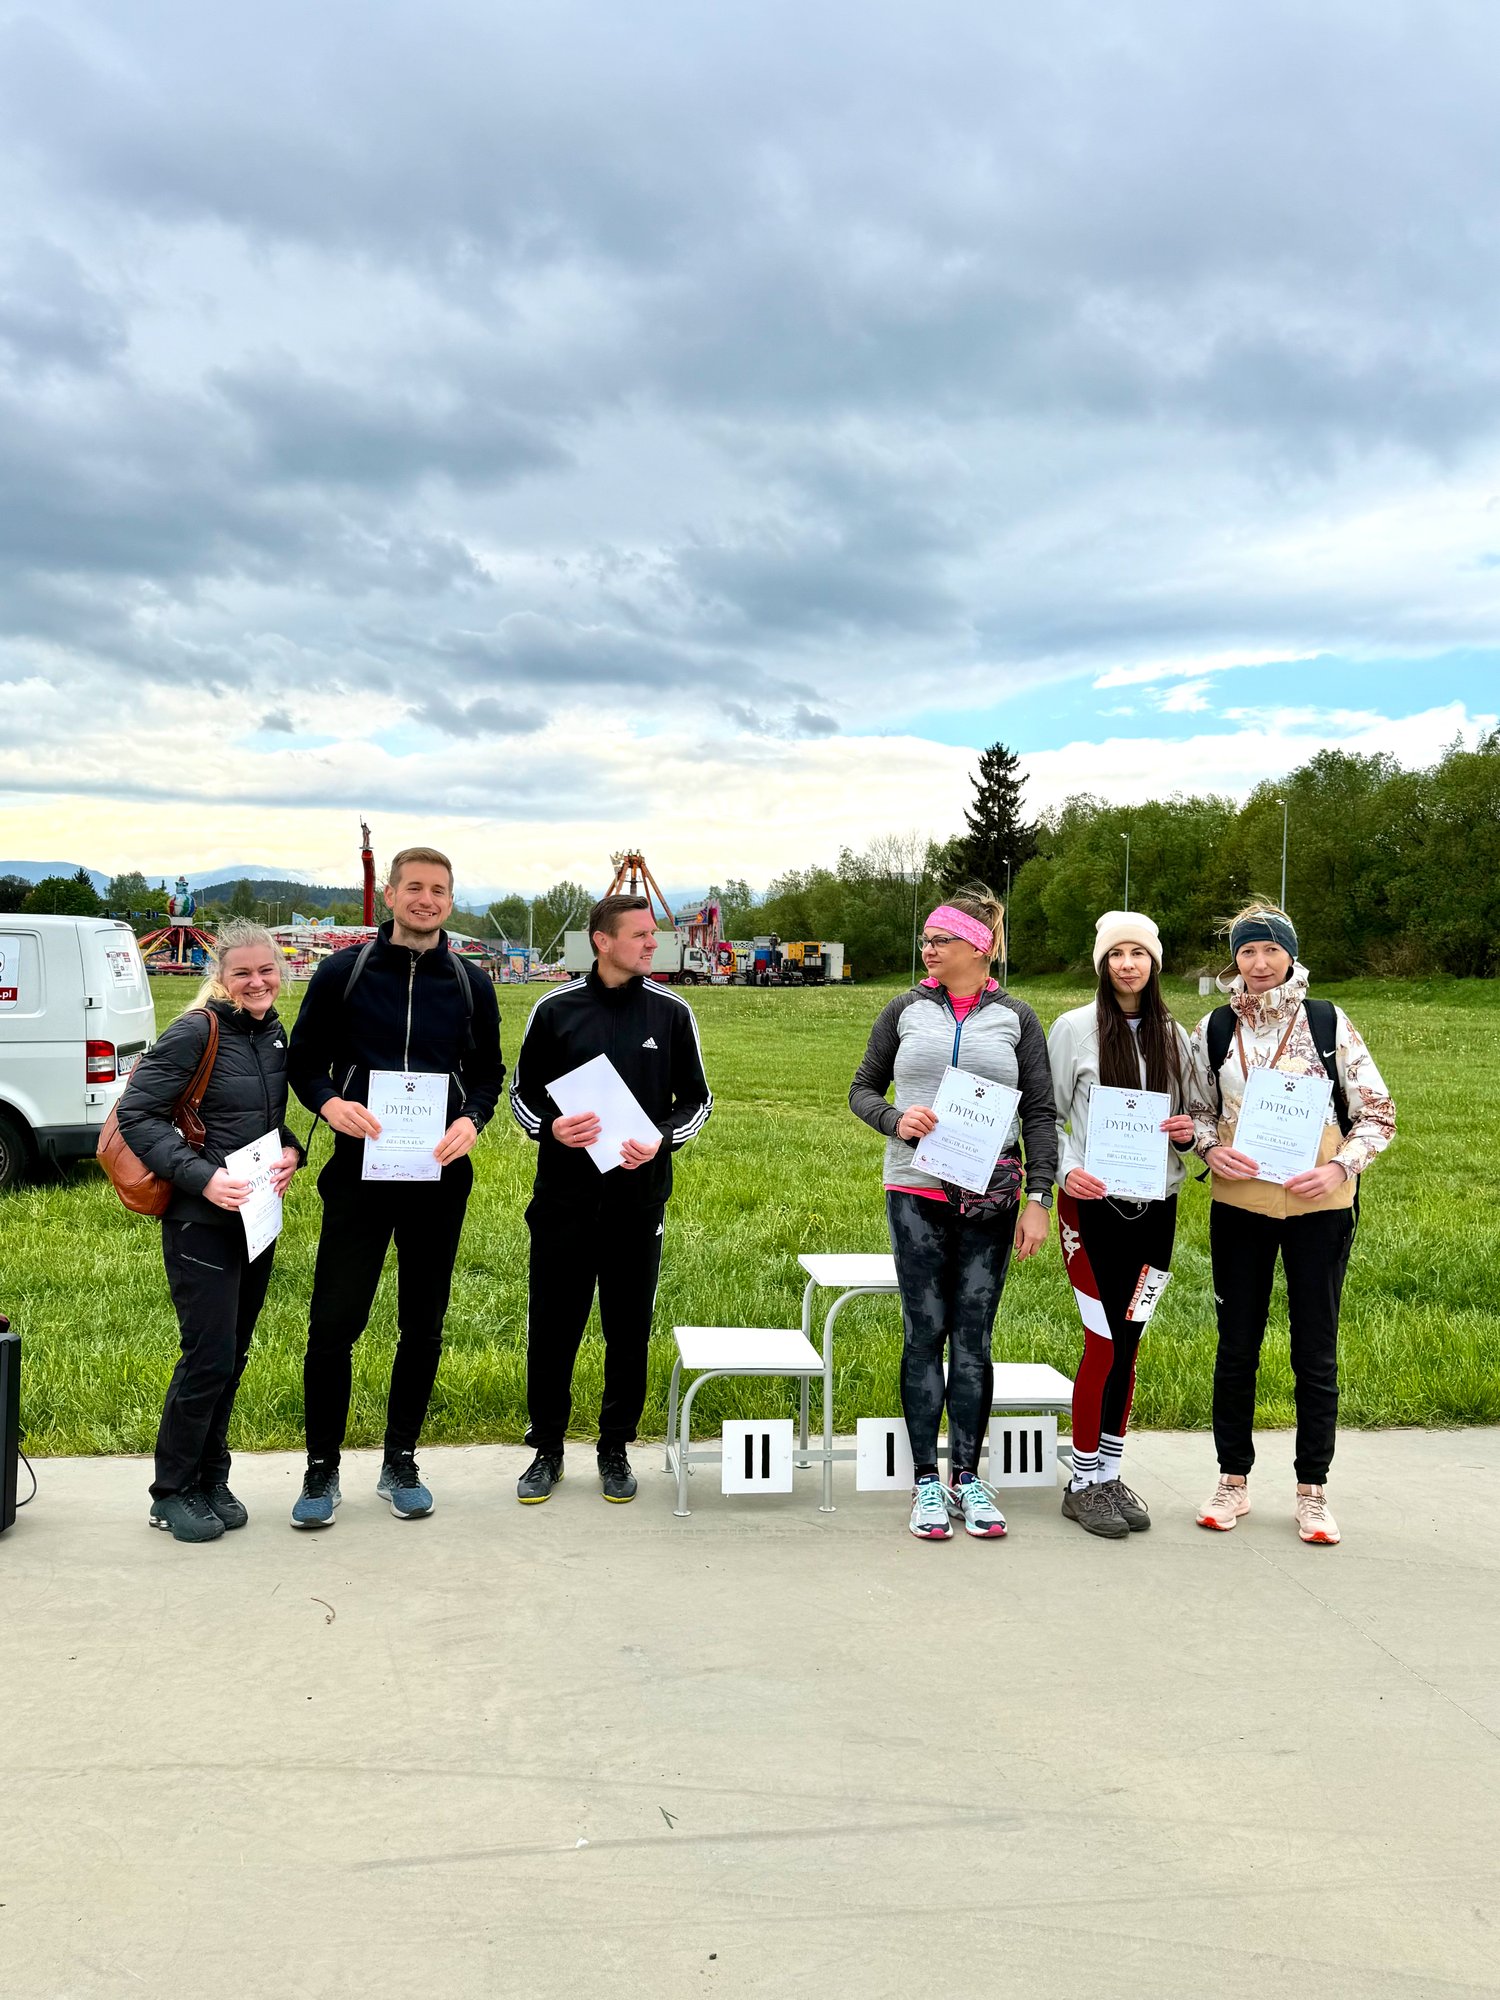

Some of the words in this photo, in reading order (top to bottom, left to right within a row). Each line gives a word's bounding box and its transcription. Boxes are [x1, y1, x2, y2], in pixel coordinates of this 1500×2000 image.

[385, 1104, 432, 1116] DYPLOM
[948, 1102, 995, 1127] DYPLOM
[1259, 1099, 1310, 1119] DYPLOM
[1105, 1119, 1154, 1134] DYPLOM
[1141, 1285, 1158, 1306] 244
[744, 1434, 770, 1479] II
[886, 1432, 895, 1477] I
[1003, 1430, 1043, 1474] III
